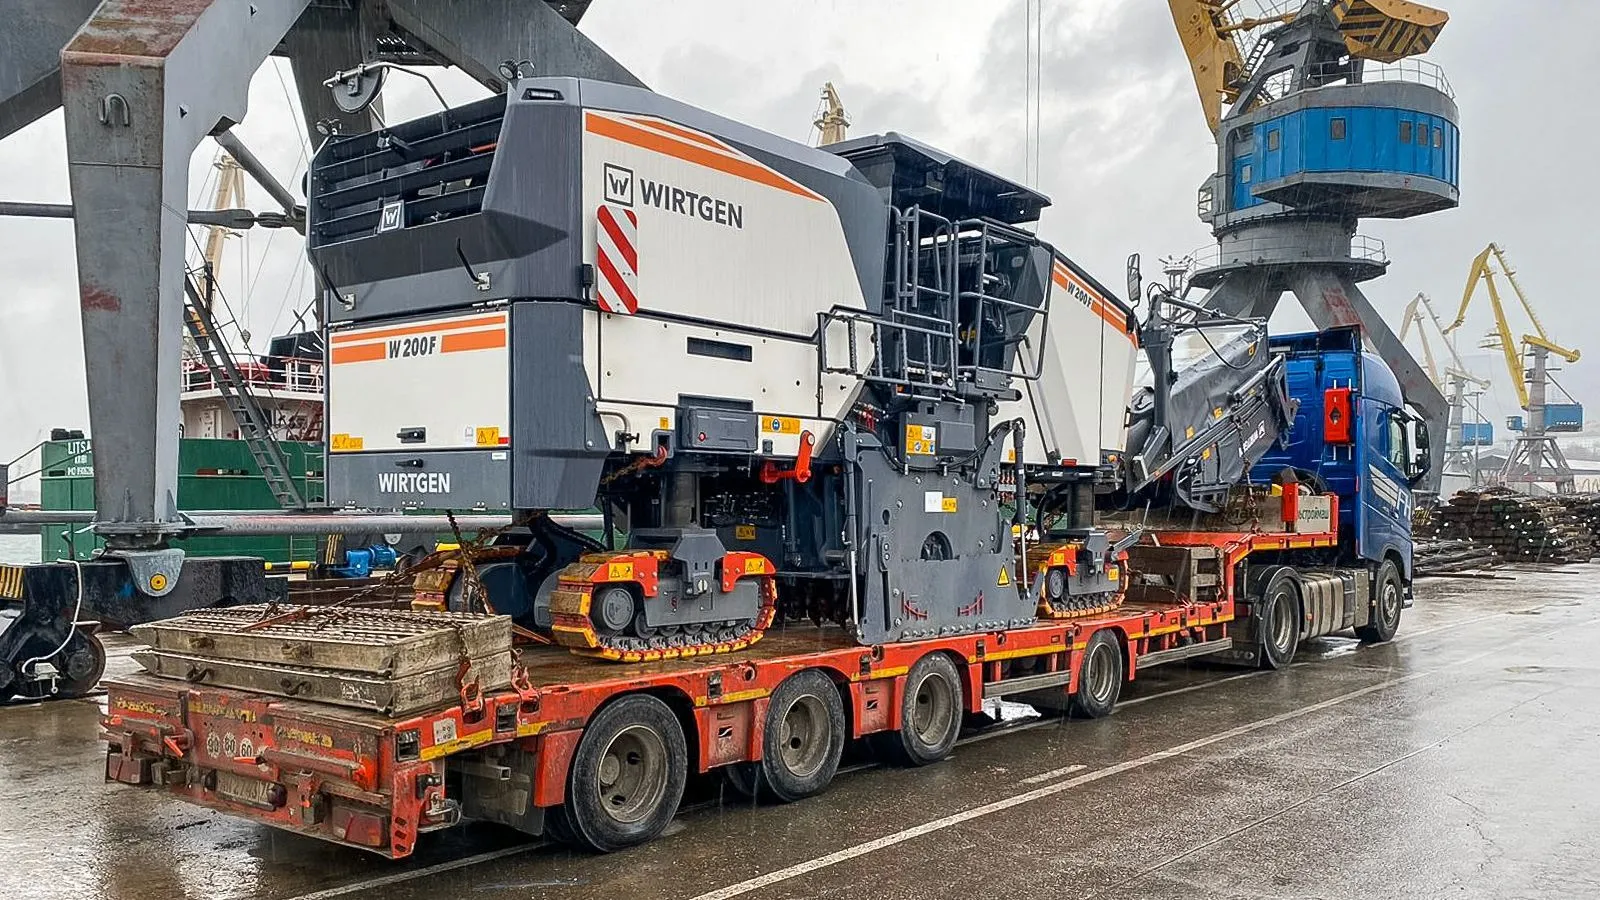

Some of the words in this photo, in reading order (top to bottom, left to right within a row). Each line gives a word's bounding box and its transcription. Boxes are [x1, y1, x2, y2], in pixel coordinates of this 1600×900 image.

[640, 178, 743, 229] WIRTGEN
[1074, 287, 1093, 308] 200F
[388, 340, 401, 359] W
[402, 335, 437, 358] 200F
[378, 471, 451, 494] WIRTGEN
[1396, 488, 1412, 522] FH
[207, 738, 220, 753] 90
[241, 743, 253, 757] 60
